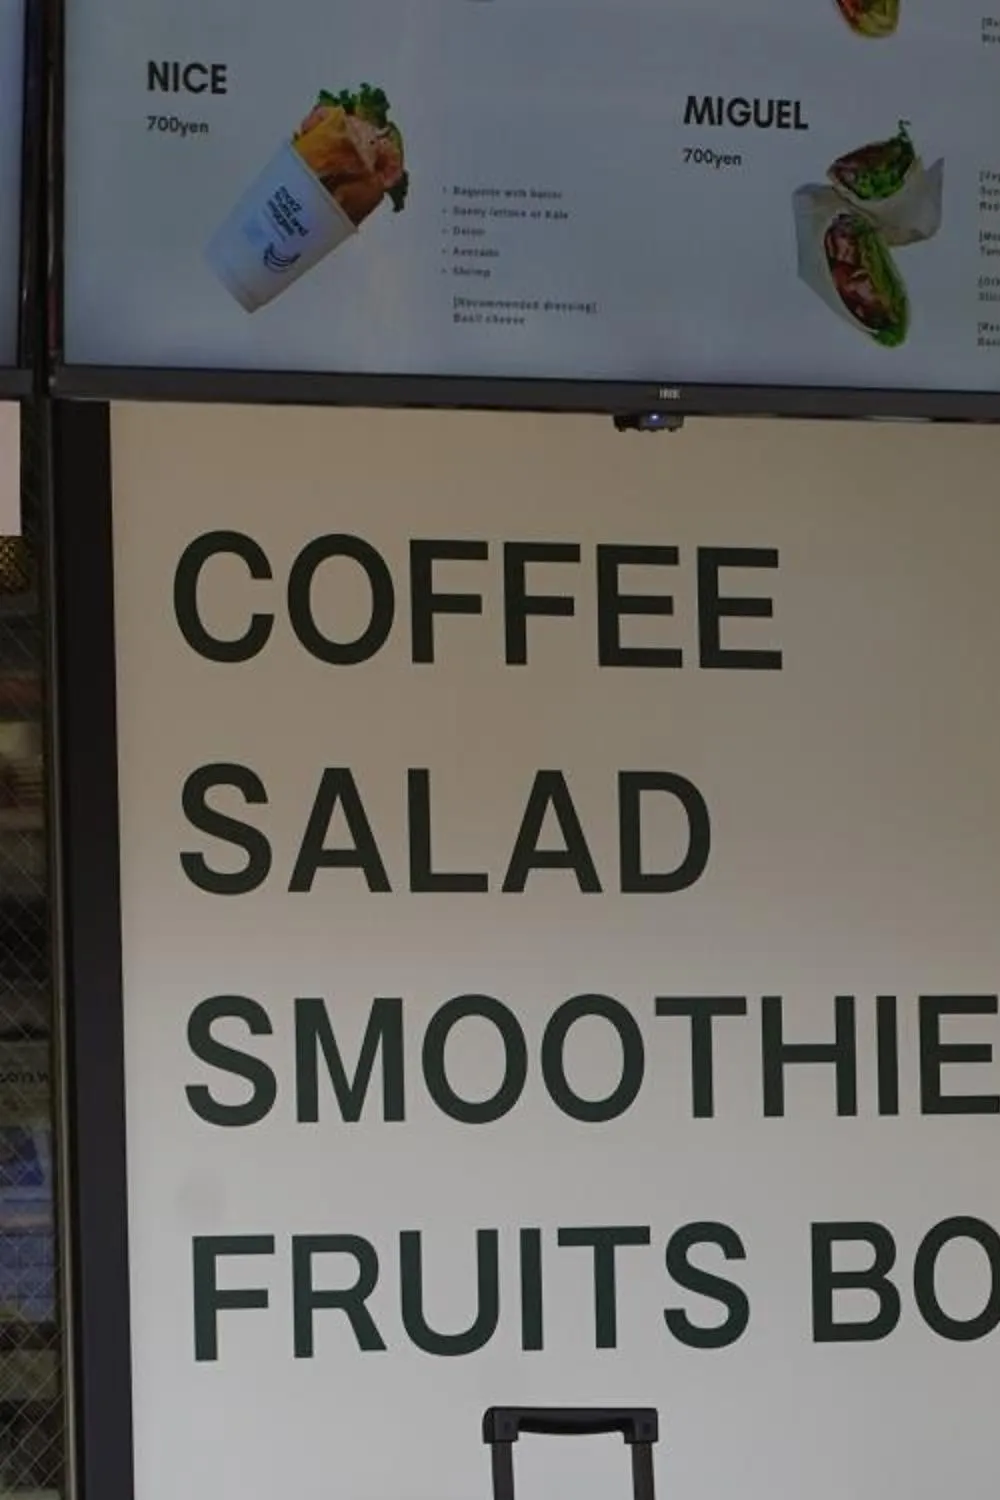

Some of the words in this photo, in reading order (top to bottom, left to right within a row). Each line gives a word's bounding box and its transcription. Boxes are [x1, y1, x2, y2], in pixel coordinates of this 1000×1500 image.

[147, 60, 227, 95] NICE
[147, 115, 209, 137] 700yen
[683, 95, 809, 130] MIGUEL
[683, 148, 742, 169] 700yen
[173, 530, 783, 671] COFFEE
[179, 762, 711, 896] SALAD
[192, 1221, 750, 1362] FRUITS
